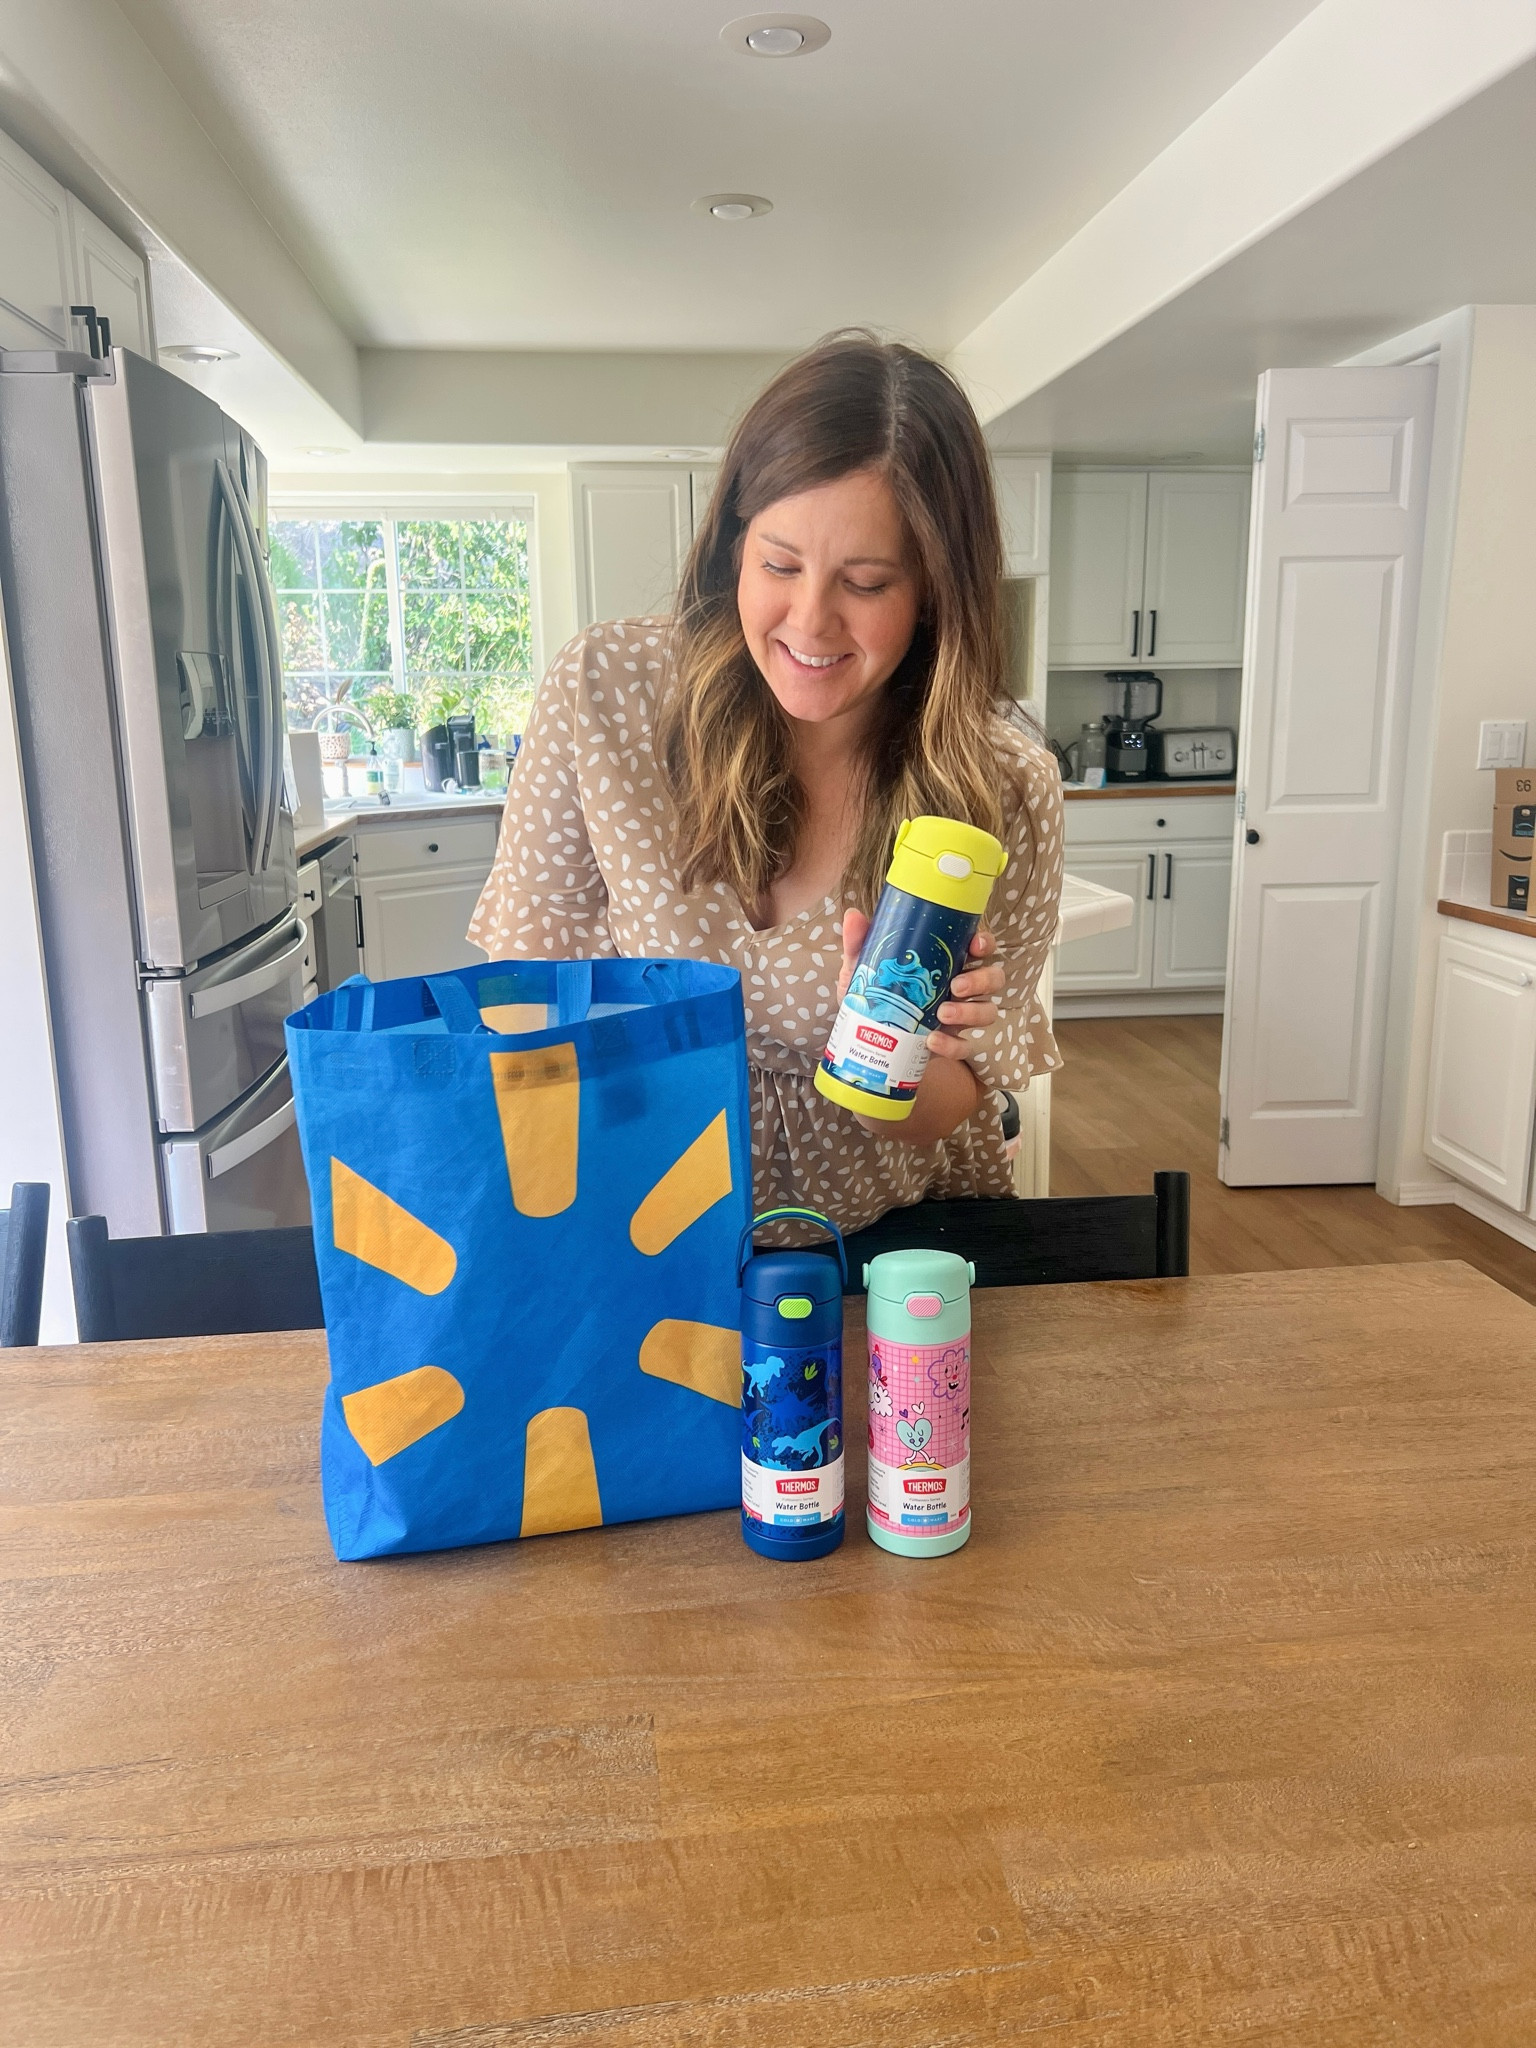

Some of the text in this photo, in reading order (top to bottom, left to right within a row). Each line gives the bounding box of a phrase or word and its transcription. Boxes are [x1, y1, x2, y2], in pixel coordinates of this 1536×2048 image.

[859, 1028, 893, 1050] THERMOS
[849, 1046, 869, 1060] Water
[869, 1056, 890, 1069] Bottle
[780, 1480, 817, 1492] THERMOS
[907, 1481, 944, 1492] THERMOS
[775, 1501, 820, 1510] Water Bottle
[902, 1502, 947, 1511] Water Bottle
